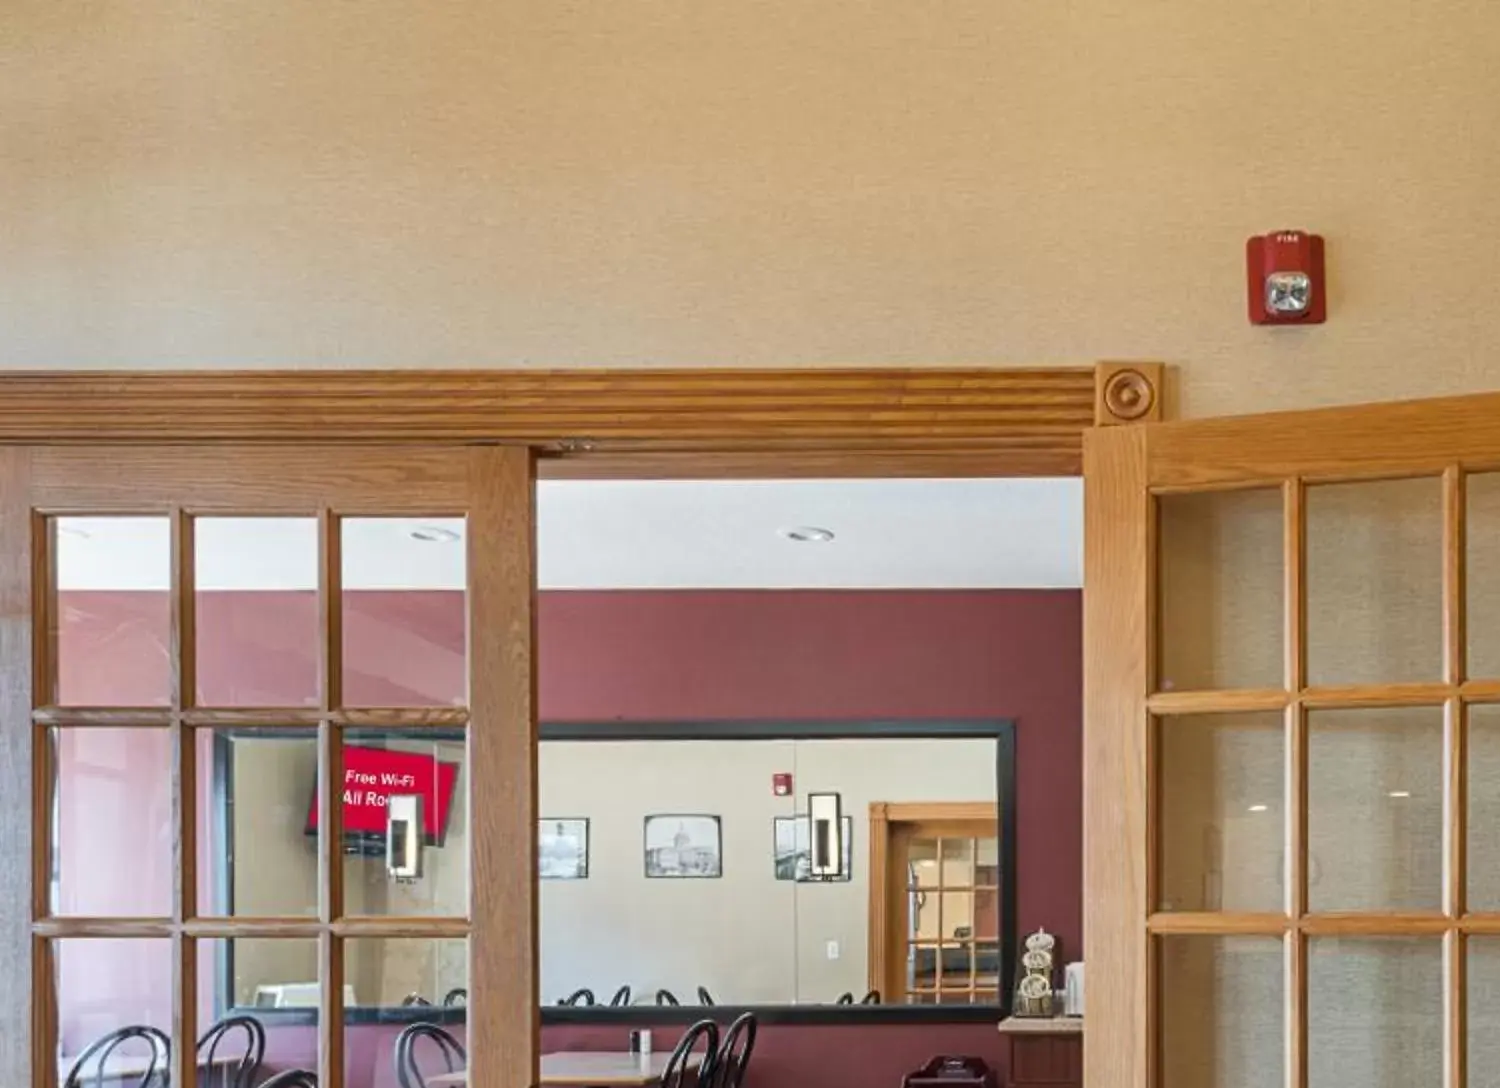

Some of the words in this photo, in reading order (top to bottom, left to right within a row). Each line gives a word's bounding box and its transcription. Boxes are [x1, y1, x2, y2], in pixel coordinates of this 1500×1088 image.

[1276, 234, 1299, 243] FIRE
[345, 769, 377, 784] Free
[343, 790, 362, 805] All
